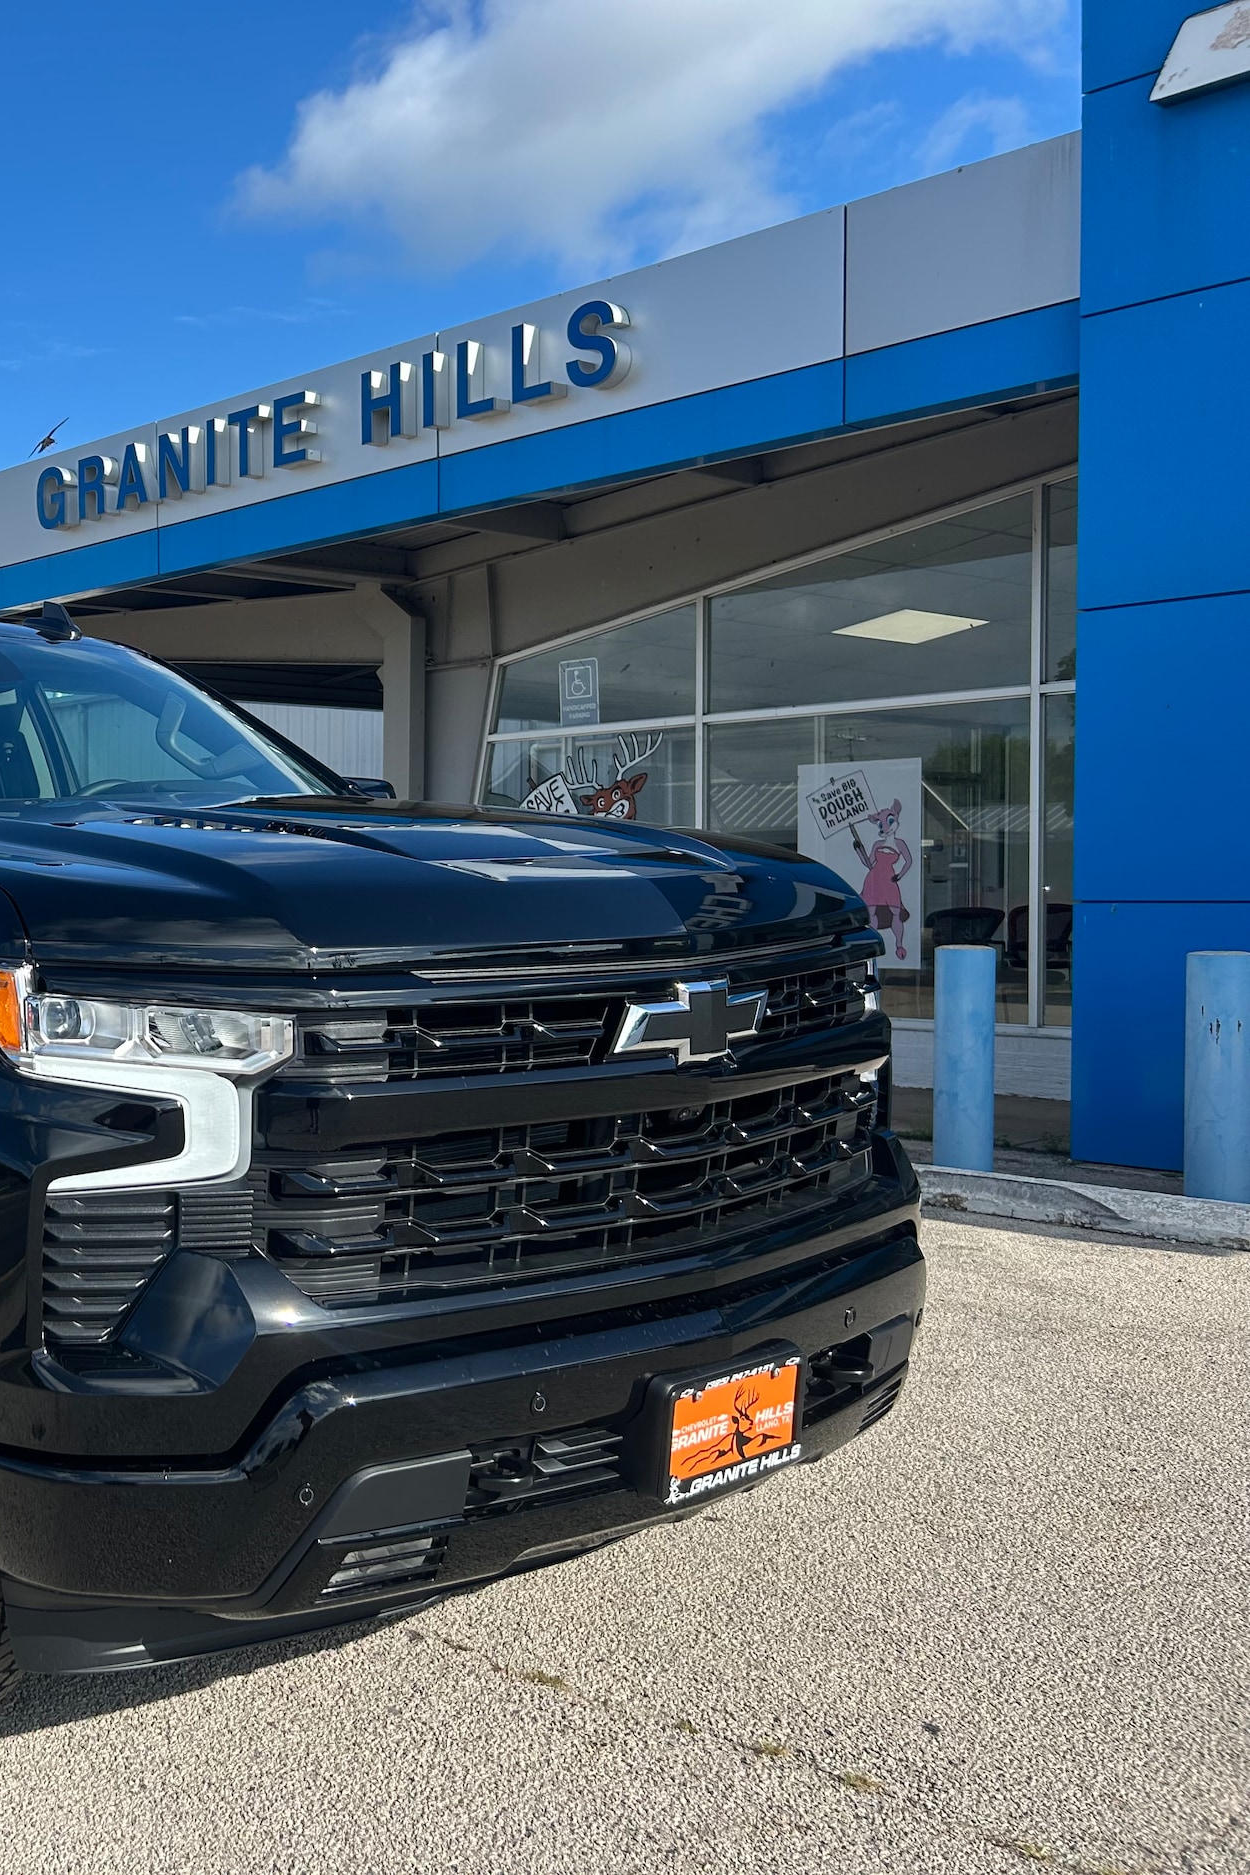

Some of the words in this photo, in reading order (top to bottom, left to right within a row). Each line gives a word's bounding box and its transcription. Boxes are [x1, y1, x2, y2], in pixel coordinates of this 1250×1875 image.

[36, 390, 321, 531] GRANITE
[361, 300, 632, 447] HILLS
[526, 779, 565, 811] SAVE
[818, 787, 864, 820] DOUGH
[820, 788, 841, 802] Save
[841, 778, 857, 792] BIG
[835, 801, 868, 823] LLANO!
[681, 1416, 717, 1434] CHEVROLET
[755, 1401, 795, 1423] HILLS
[781, 1415, 791, 1424] TX
[671, 1421, 729, 1452] GRANITE
[690, 1459, 759, 1494] GRANITE
[759, 1443, 802, 1471] HILLS
